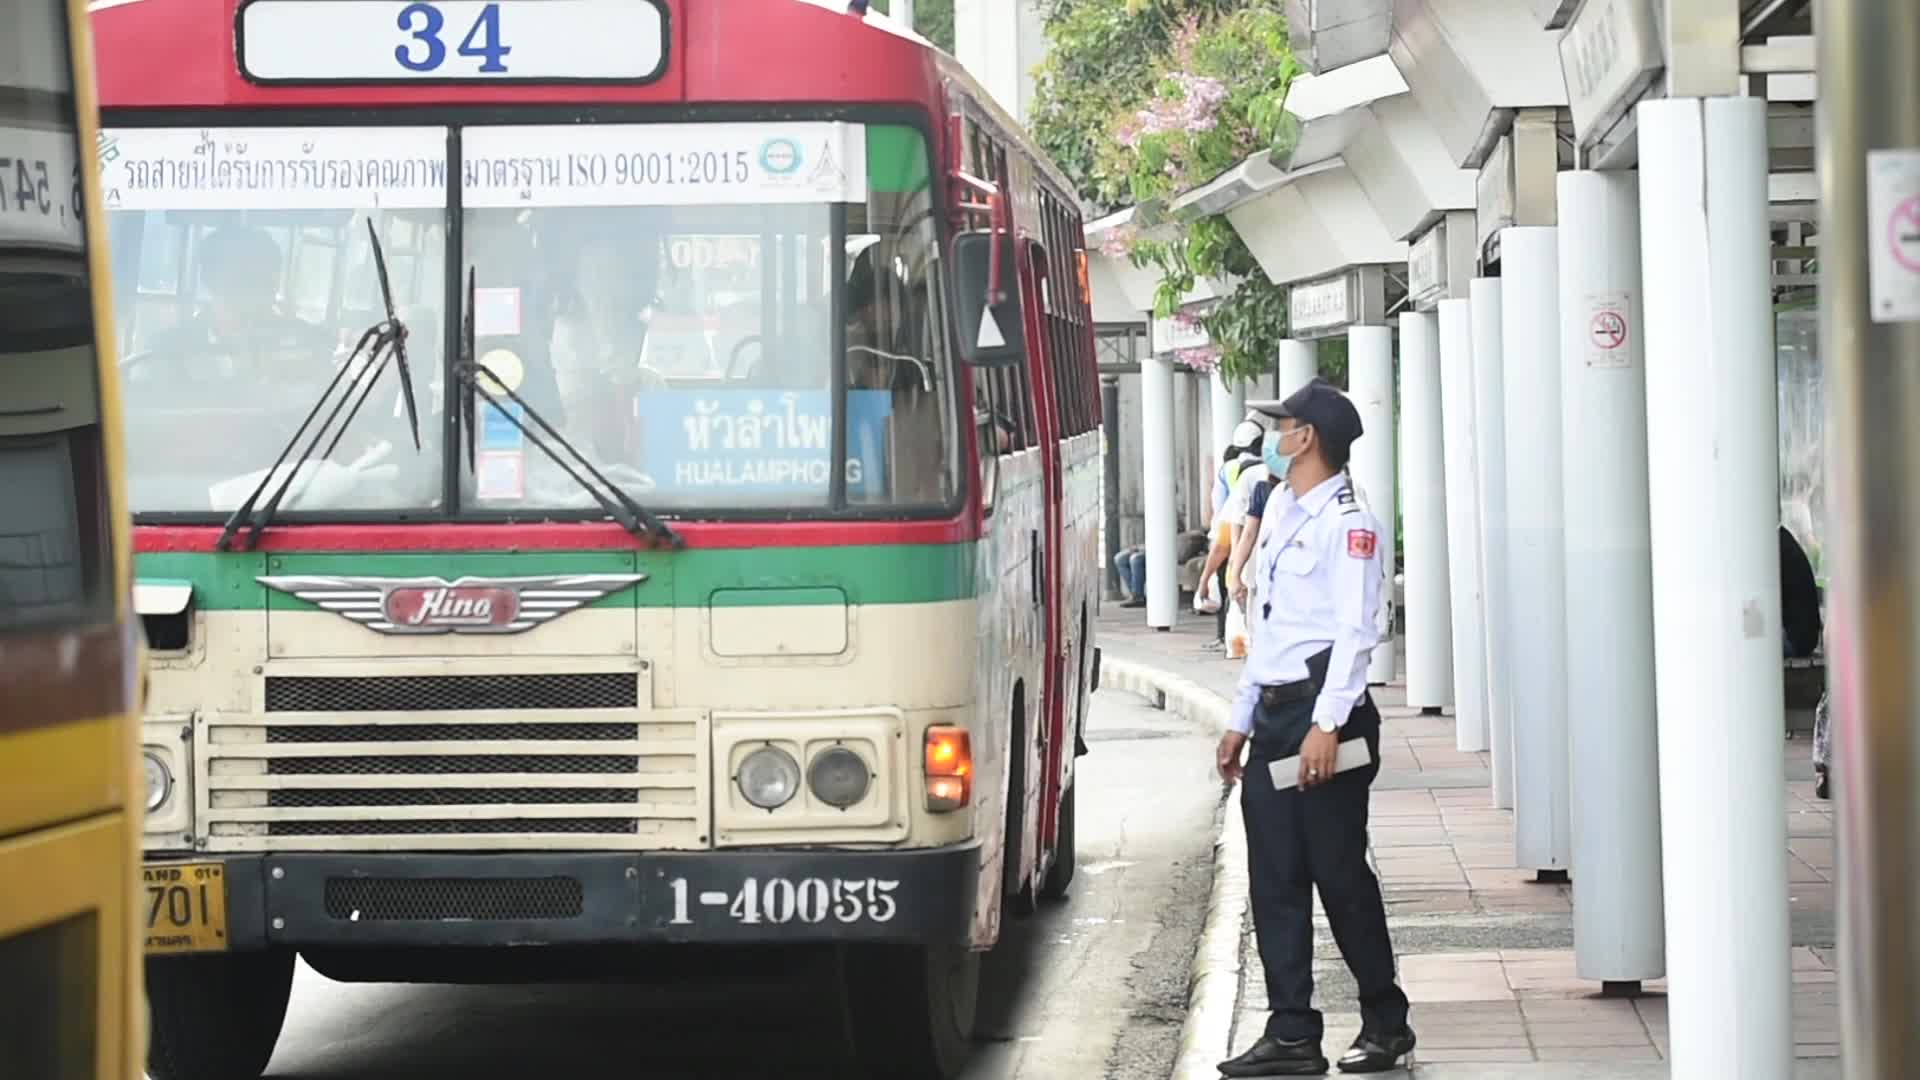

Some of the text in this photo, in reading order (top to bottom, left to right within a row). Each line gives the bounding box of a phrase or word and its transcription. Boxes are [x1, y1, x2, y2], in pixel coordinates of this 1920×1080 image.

[395, 3, 512, 73] 34
[568, 153, 606, 186] ISO
[615, 151, 749, 185] 9001:2015
[674, 457, 863, 485] HUALAMPHOG
[408, 588, 492, 624] Hino
[669, 877, 899, 924] 1-40055
